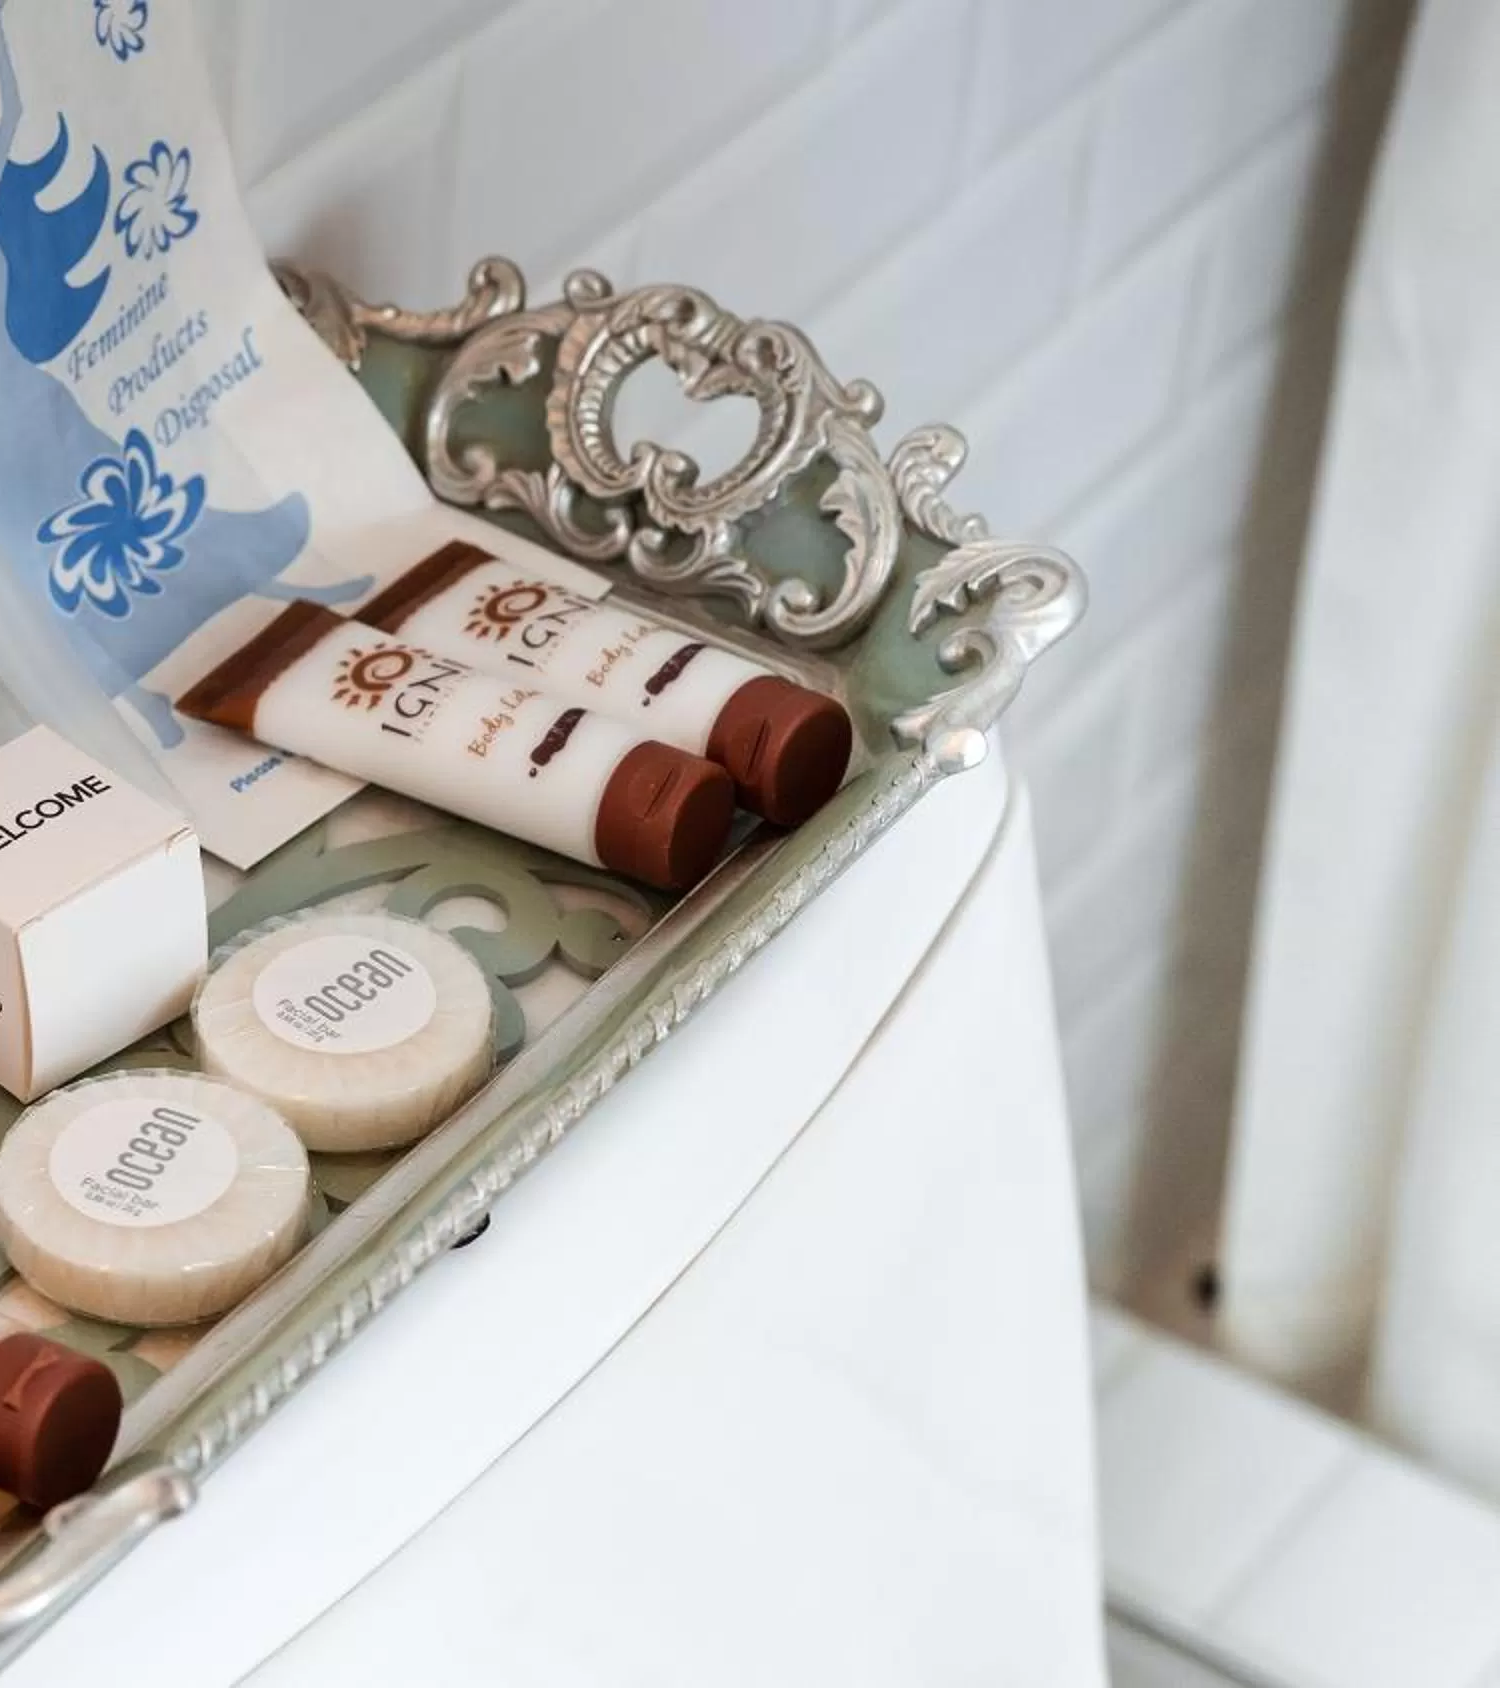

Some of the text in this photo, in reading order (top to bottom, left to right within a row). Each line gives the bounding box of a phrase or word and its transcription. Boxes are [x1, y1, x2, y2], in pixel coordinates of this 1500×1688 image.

[68, 272, 168, 382] Feminine
[108, 310, 209, 416] Products
[153, 326, 263, 448] Disposal
[506, 594, 598, 667] IGNI
[381, 657, 474, 738] IGNI
[467, 715, 516, 758] Body
[303, 948, 413, 1023] ocean
[105, 1106, 203, 1192] ocean
